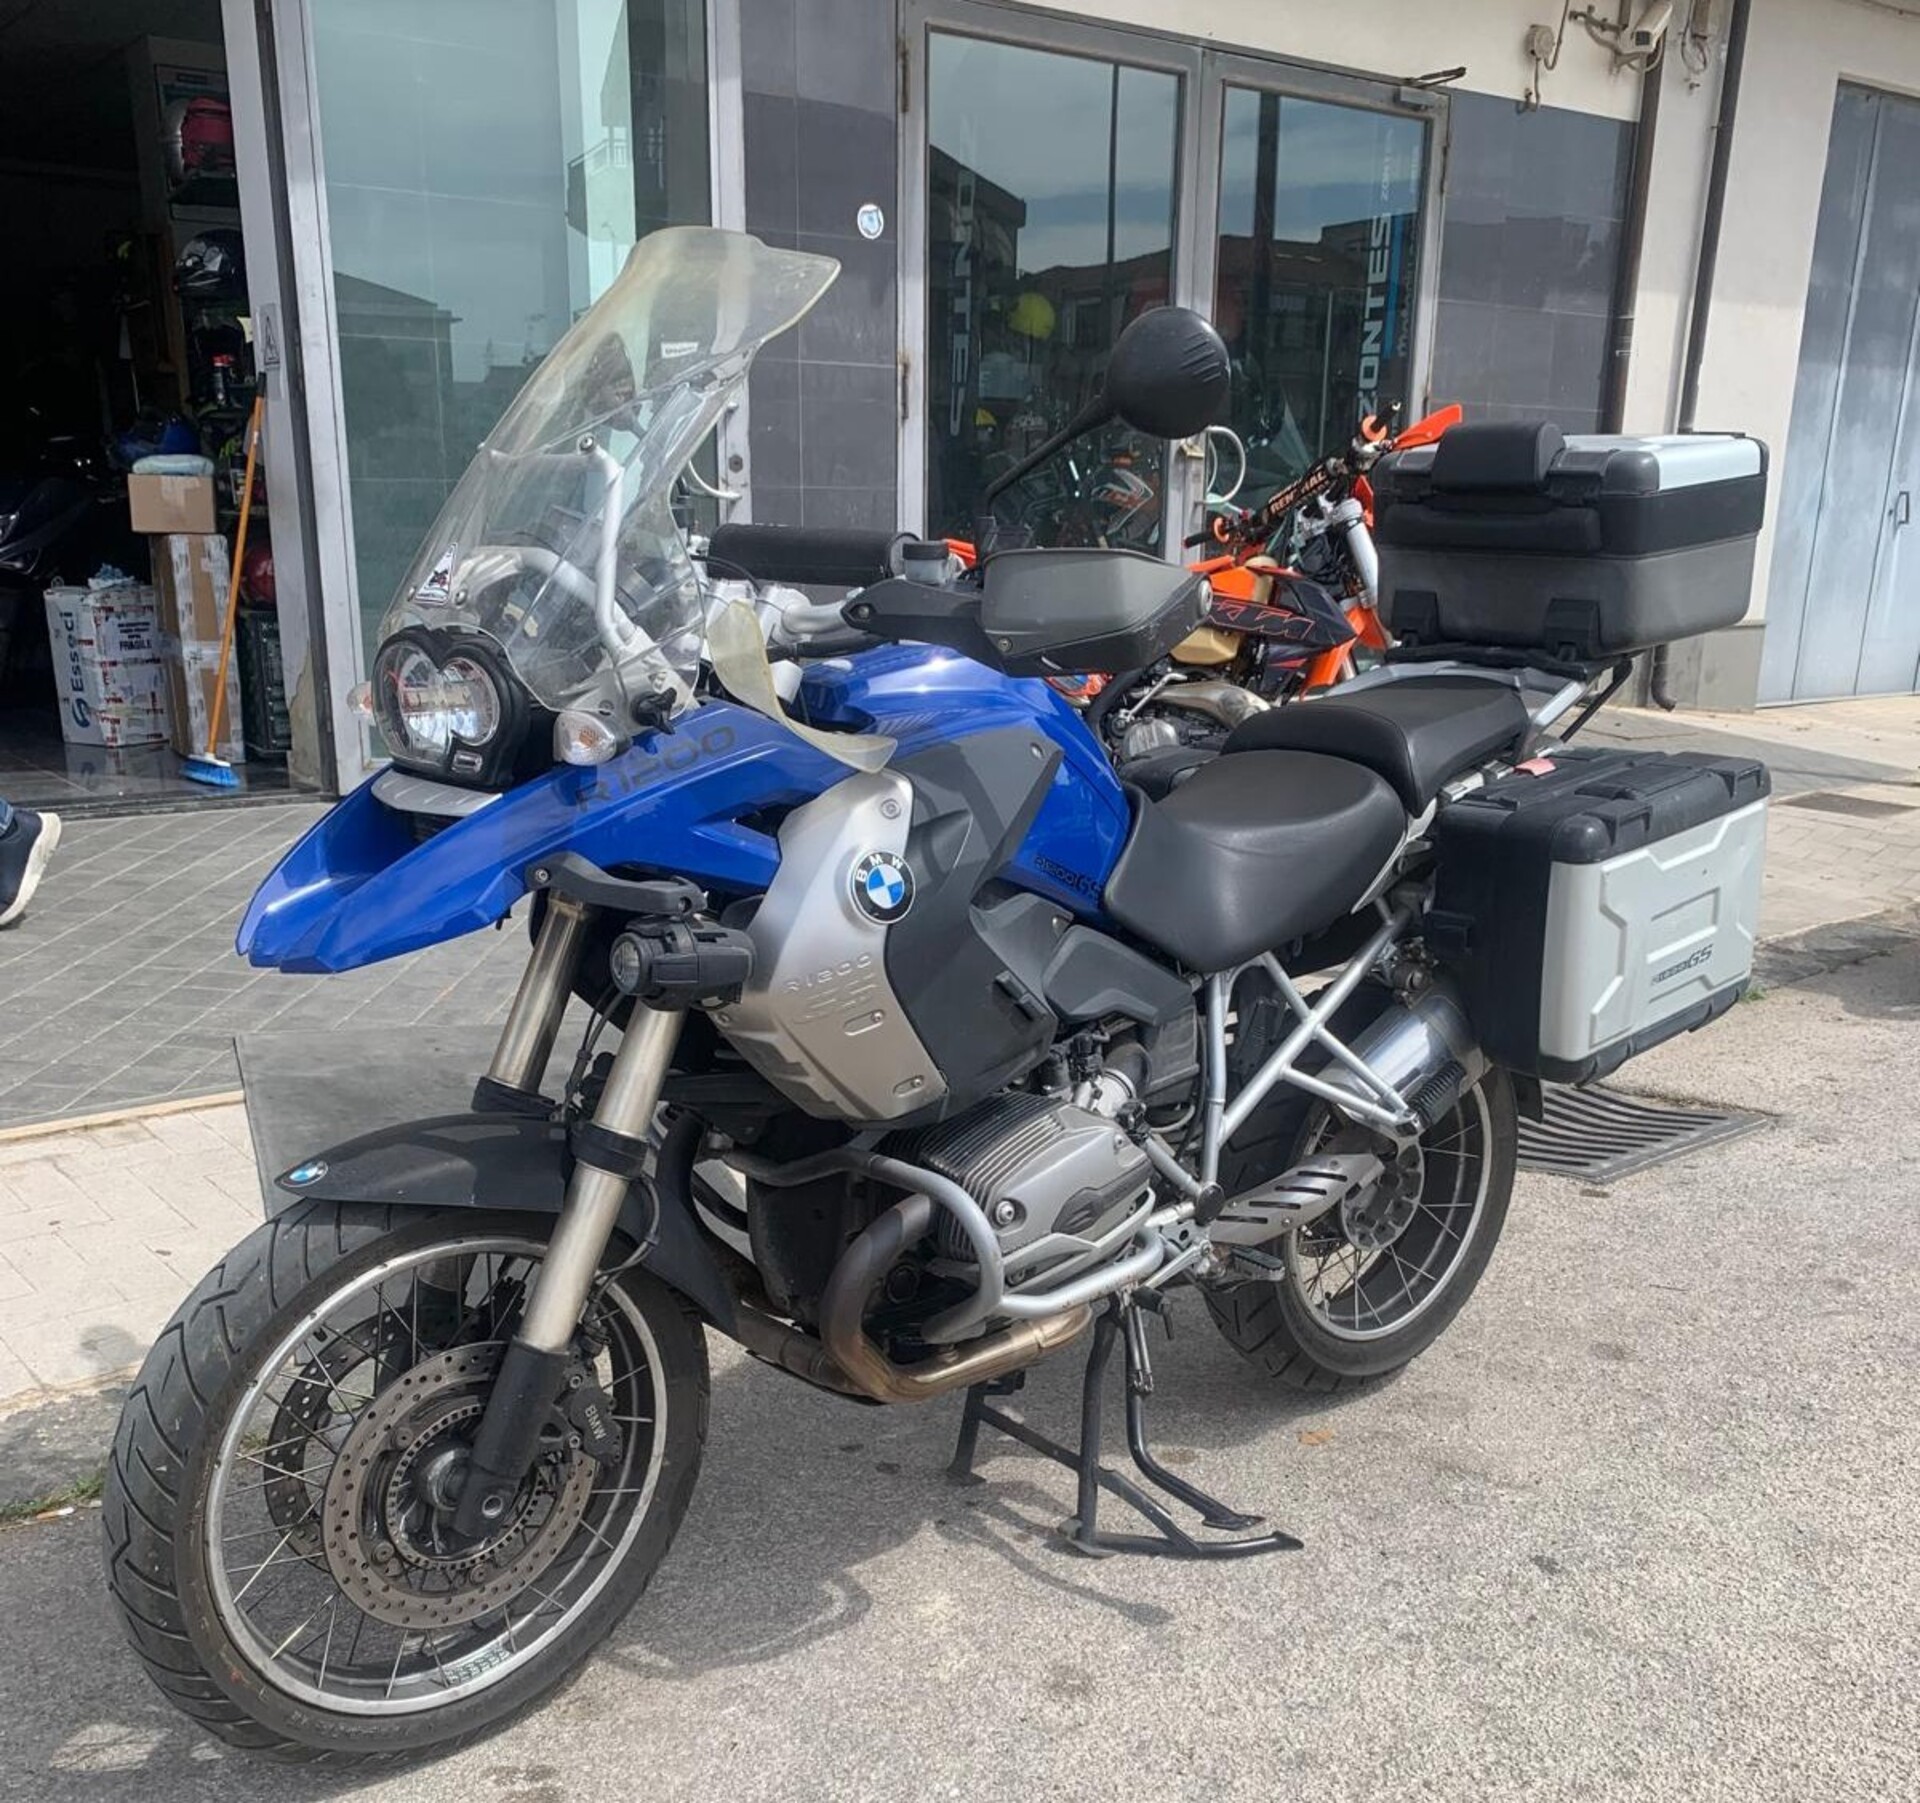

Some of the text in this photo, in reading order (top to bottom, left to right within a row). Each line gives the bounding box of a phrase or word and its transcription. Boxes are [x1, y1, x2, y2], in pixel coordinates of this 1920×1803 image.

[1357, 212, 1392, 422] ZONTES
[574, 724, 736, 813] R1200
[856, 853, 904, 883] BMW
[585, 1404, 607, 1440] BMW
